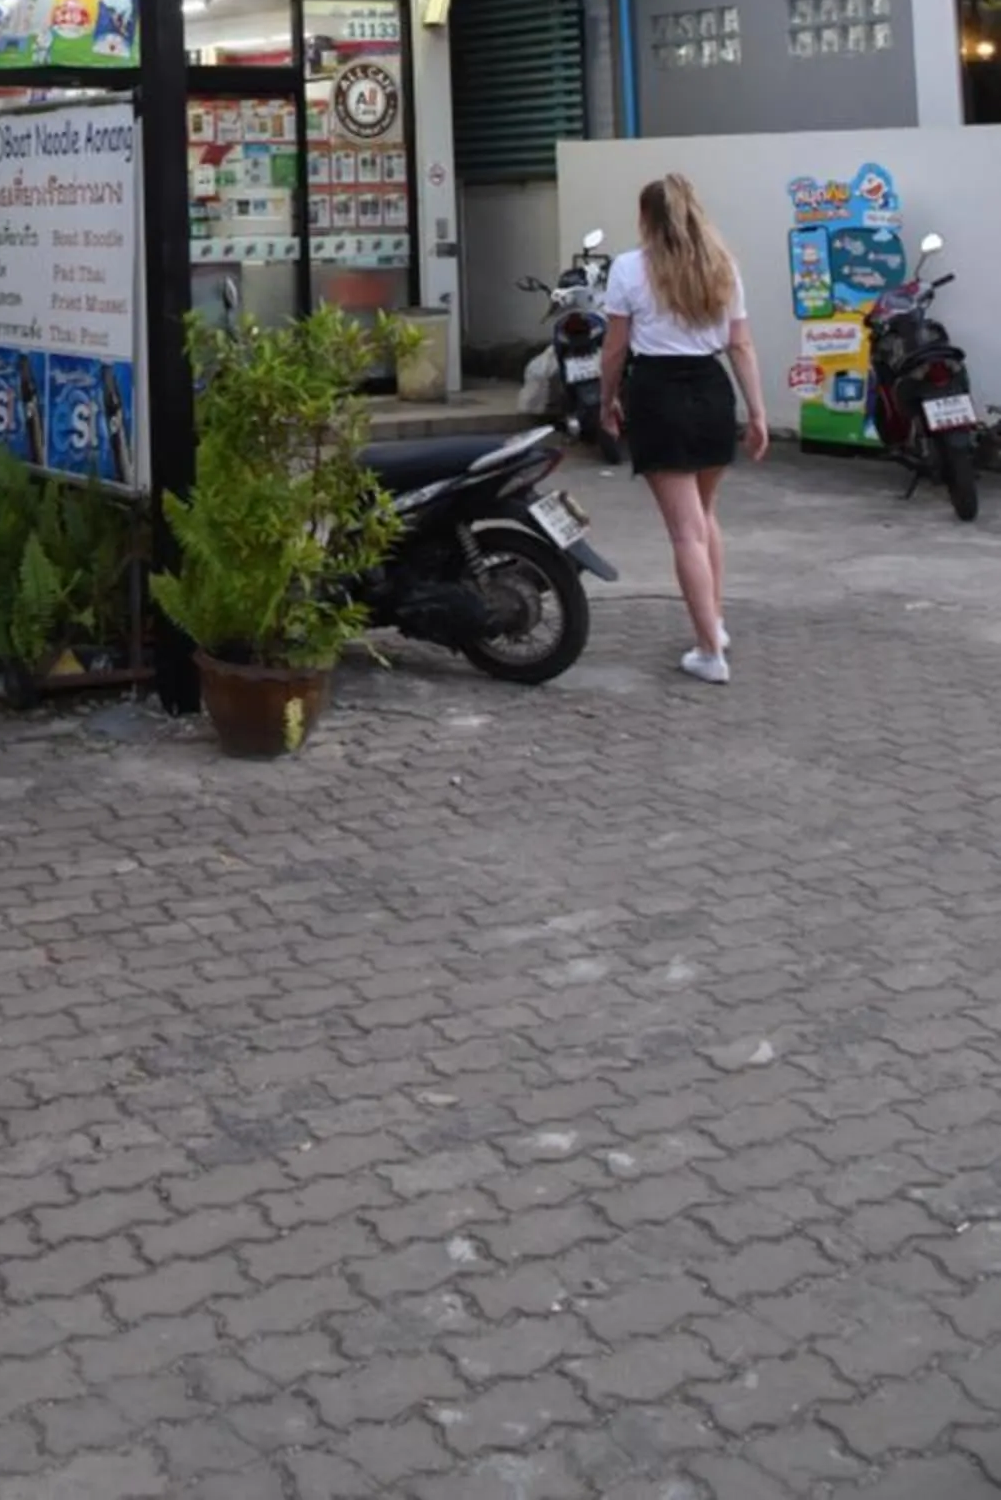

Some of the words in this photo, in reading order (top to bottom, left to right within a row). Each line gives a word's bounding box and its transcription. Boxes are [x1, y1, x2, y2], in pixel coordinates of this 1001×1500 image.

[3, 124, 32, 159] Boat
[34, 119, 80, 156] Noodle
[84, 120, 134, 164] Aonang
